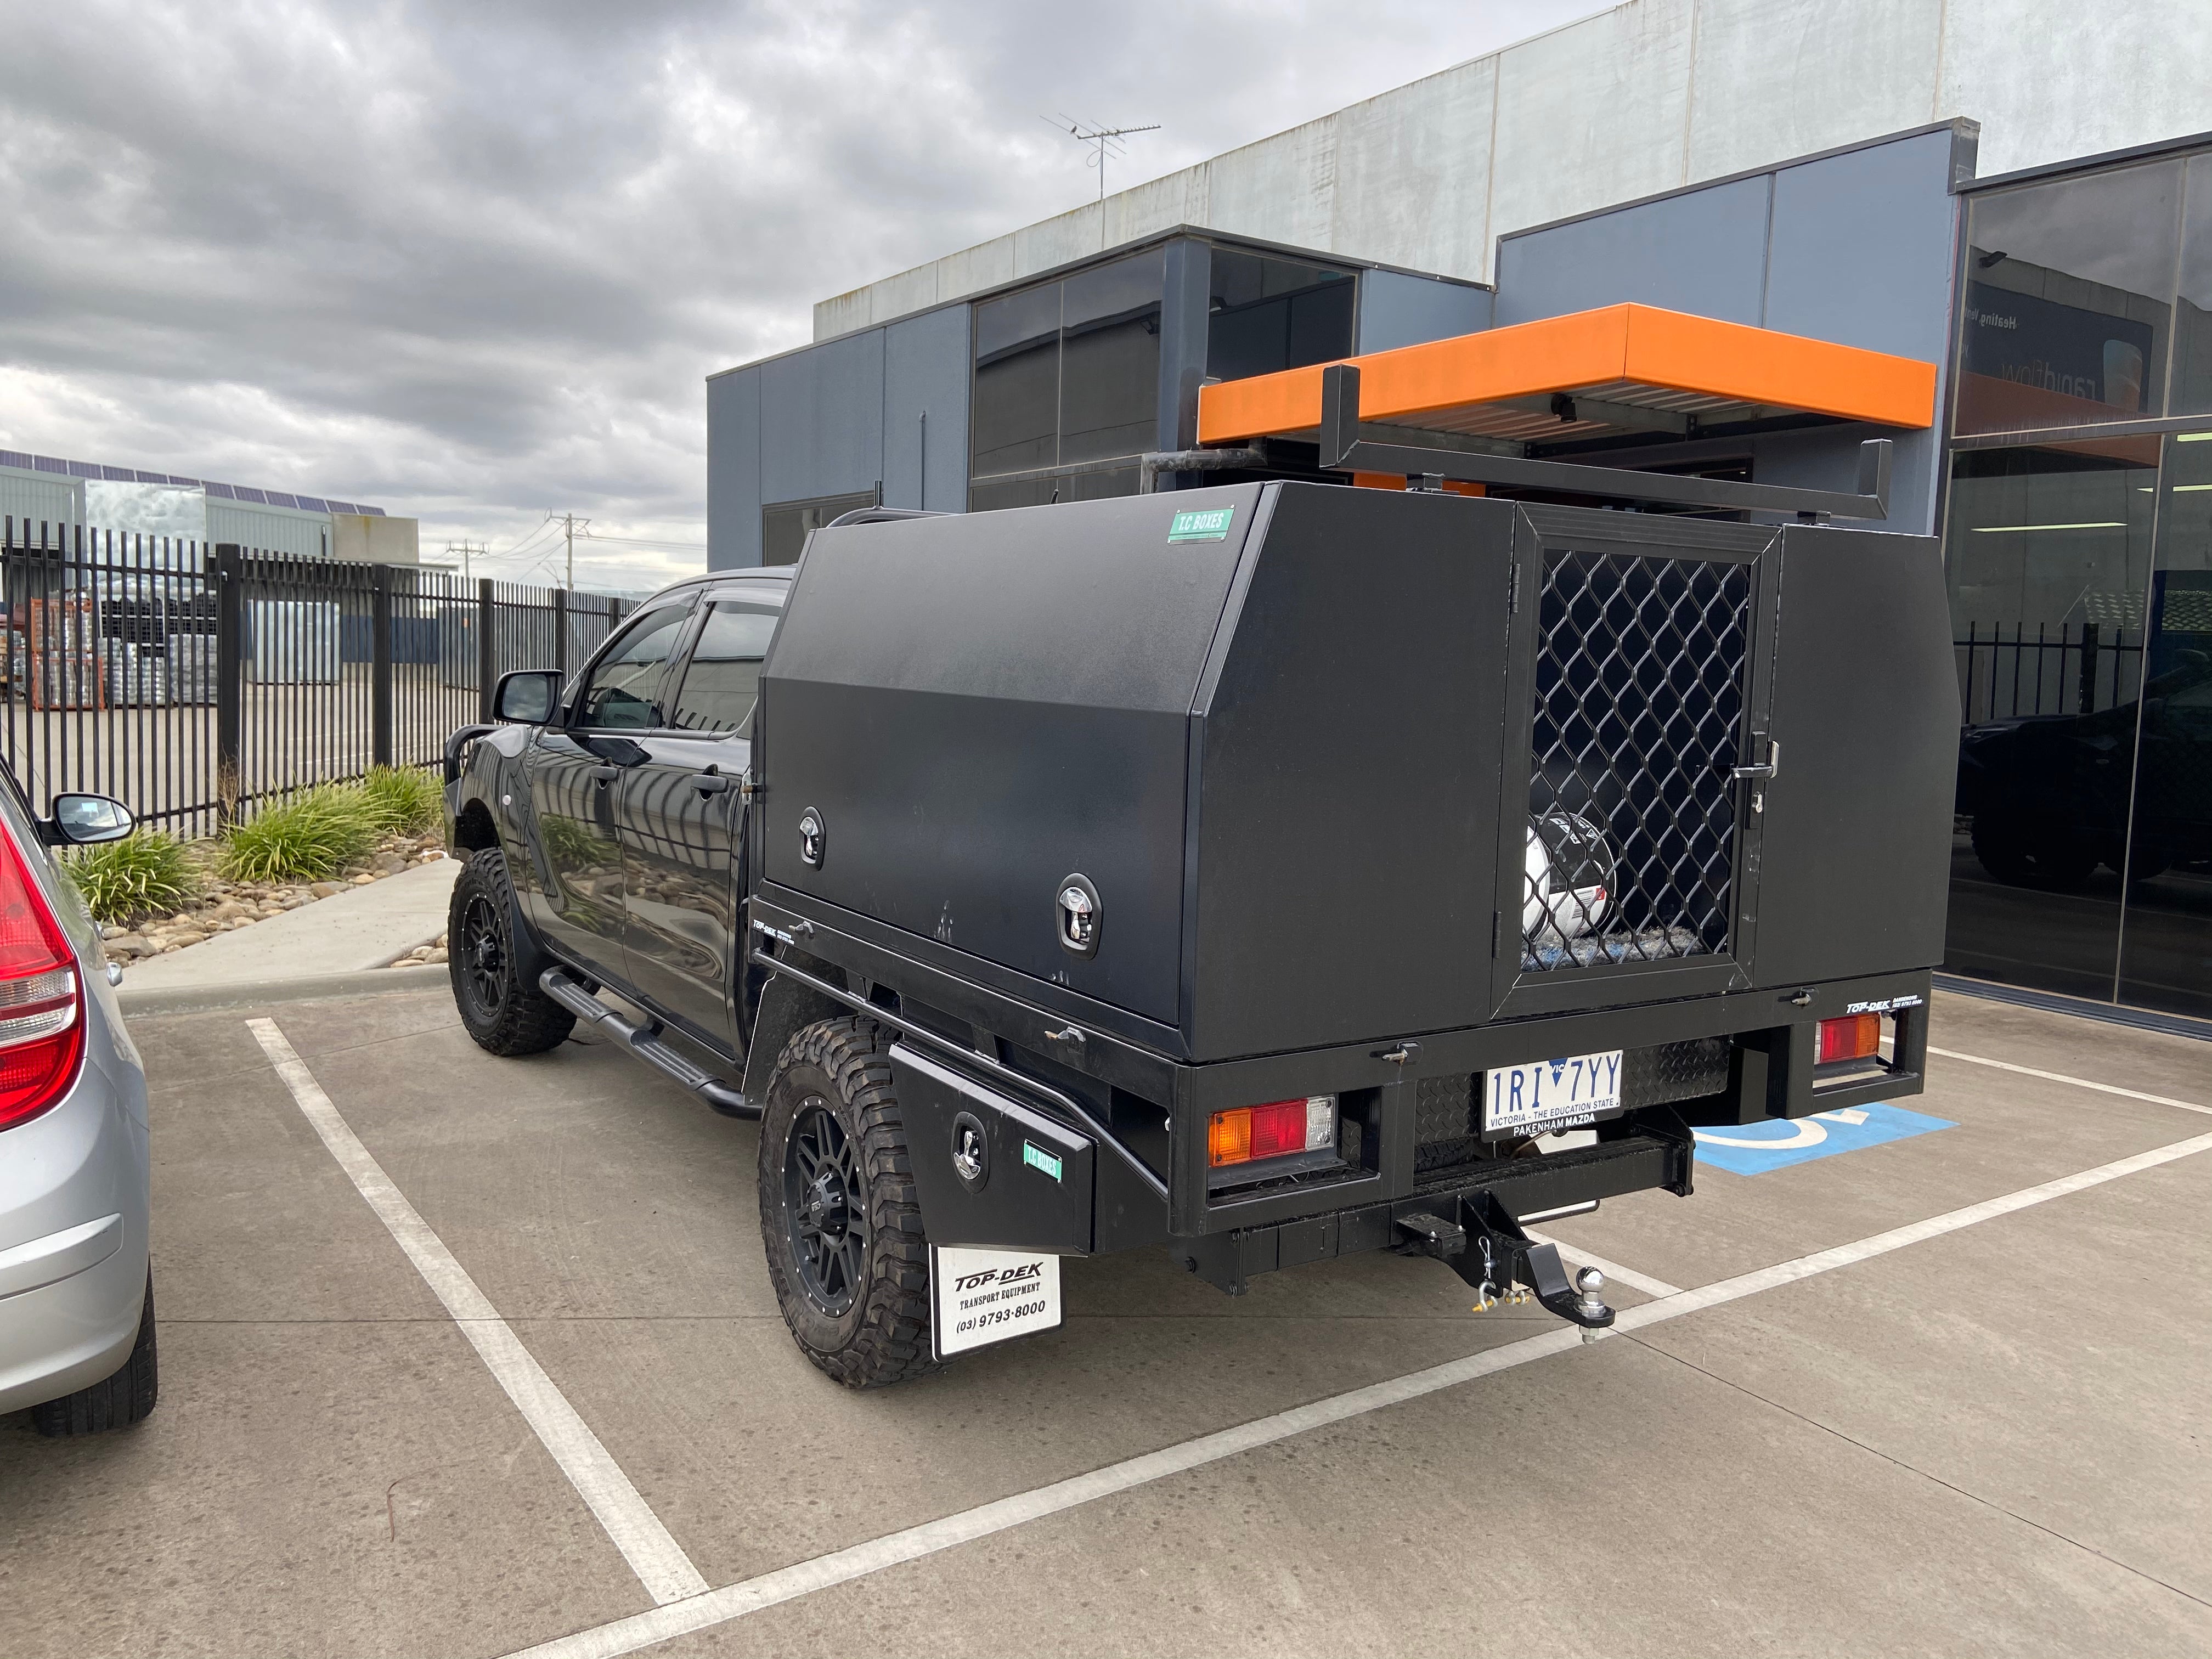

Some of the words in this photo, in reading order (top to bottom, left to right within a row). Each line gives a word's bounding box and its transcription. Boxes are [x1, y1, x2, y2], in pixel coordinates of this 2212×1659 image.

[1178, 515, 1192, 531] T.C
[1193, 512, 1224, 529] BOXES
[753, 919, 777, 937] TOP-DEK
[1846, 1000, 1891, 1014] TOP-DEK
[1551, 1063, 1564, 1074] VIC
[1493, 1066, 1543, 1115] 1RI
[1570, 1053, 1621, 1101] 7YY
[1491, 1113, 1526, 1127] VICTORIA
[1533, 1111, 1548, 1120] THE
[1550, 1102, 1592, 1118] EDUCATION
[1593, 1098, 1614, 1109] STATE
[1513, 1118, 1564, 1137] PAKENHAM
[1565, 1113, 1595, 1127] MAZDA
[1037, 1153, 1057, 1176] BOXES
[955, 1262, 1044, 1292] TOP-DEK
[960, 1293, 1000, 1311] TRANSPORT
[1001, 1282, 1041, 1299] EQUIPMENT
[956, 1317, 977, 1334] (03)
